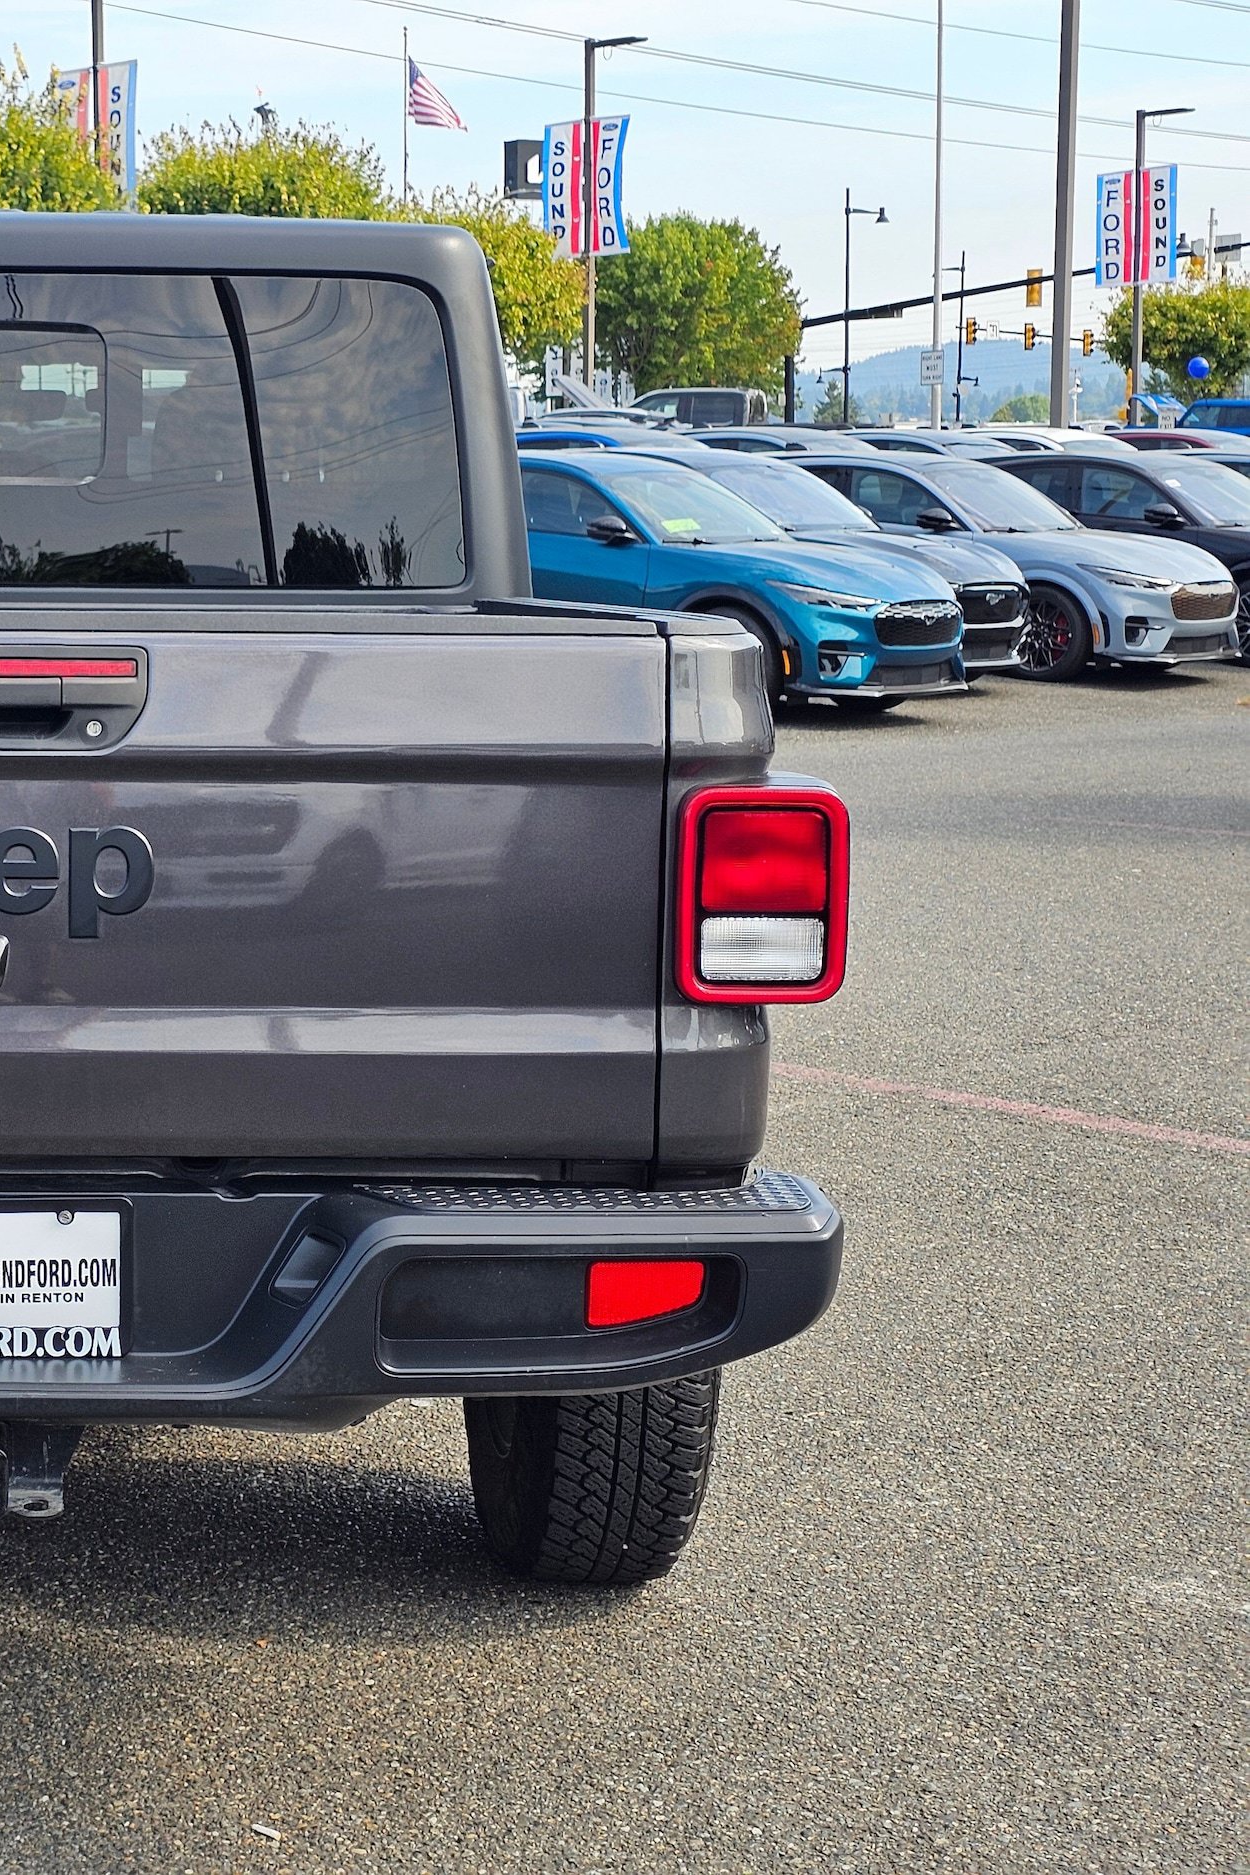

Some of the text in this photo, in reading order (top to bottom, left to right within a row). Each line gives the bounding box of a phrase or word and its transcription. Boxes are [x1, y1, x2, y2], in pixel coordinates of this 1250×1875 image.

[110, 85, 122, 192] SOUN
[551, 141, 566, 240] SOUND
[598, 138, 615, 247] FORD
[1103, 190, 1120, 280] FORD
[1154, 179, 1167, 268] SOUND
[0, 1292, 84, 1304] IN RENTON
